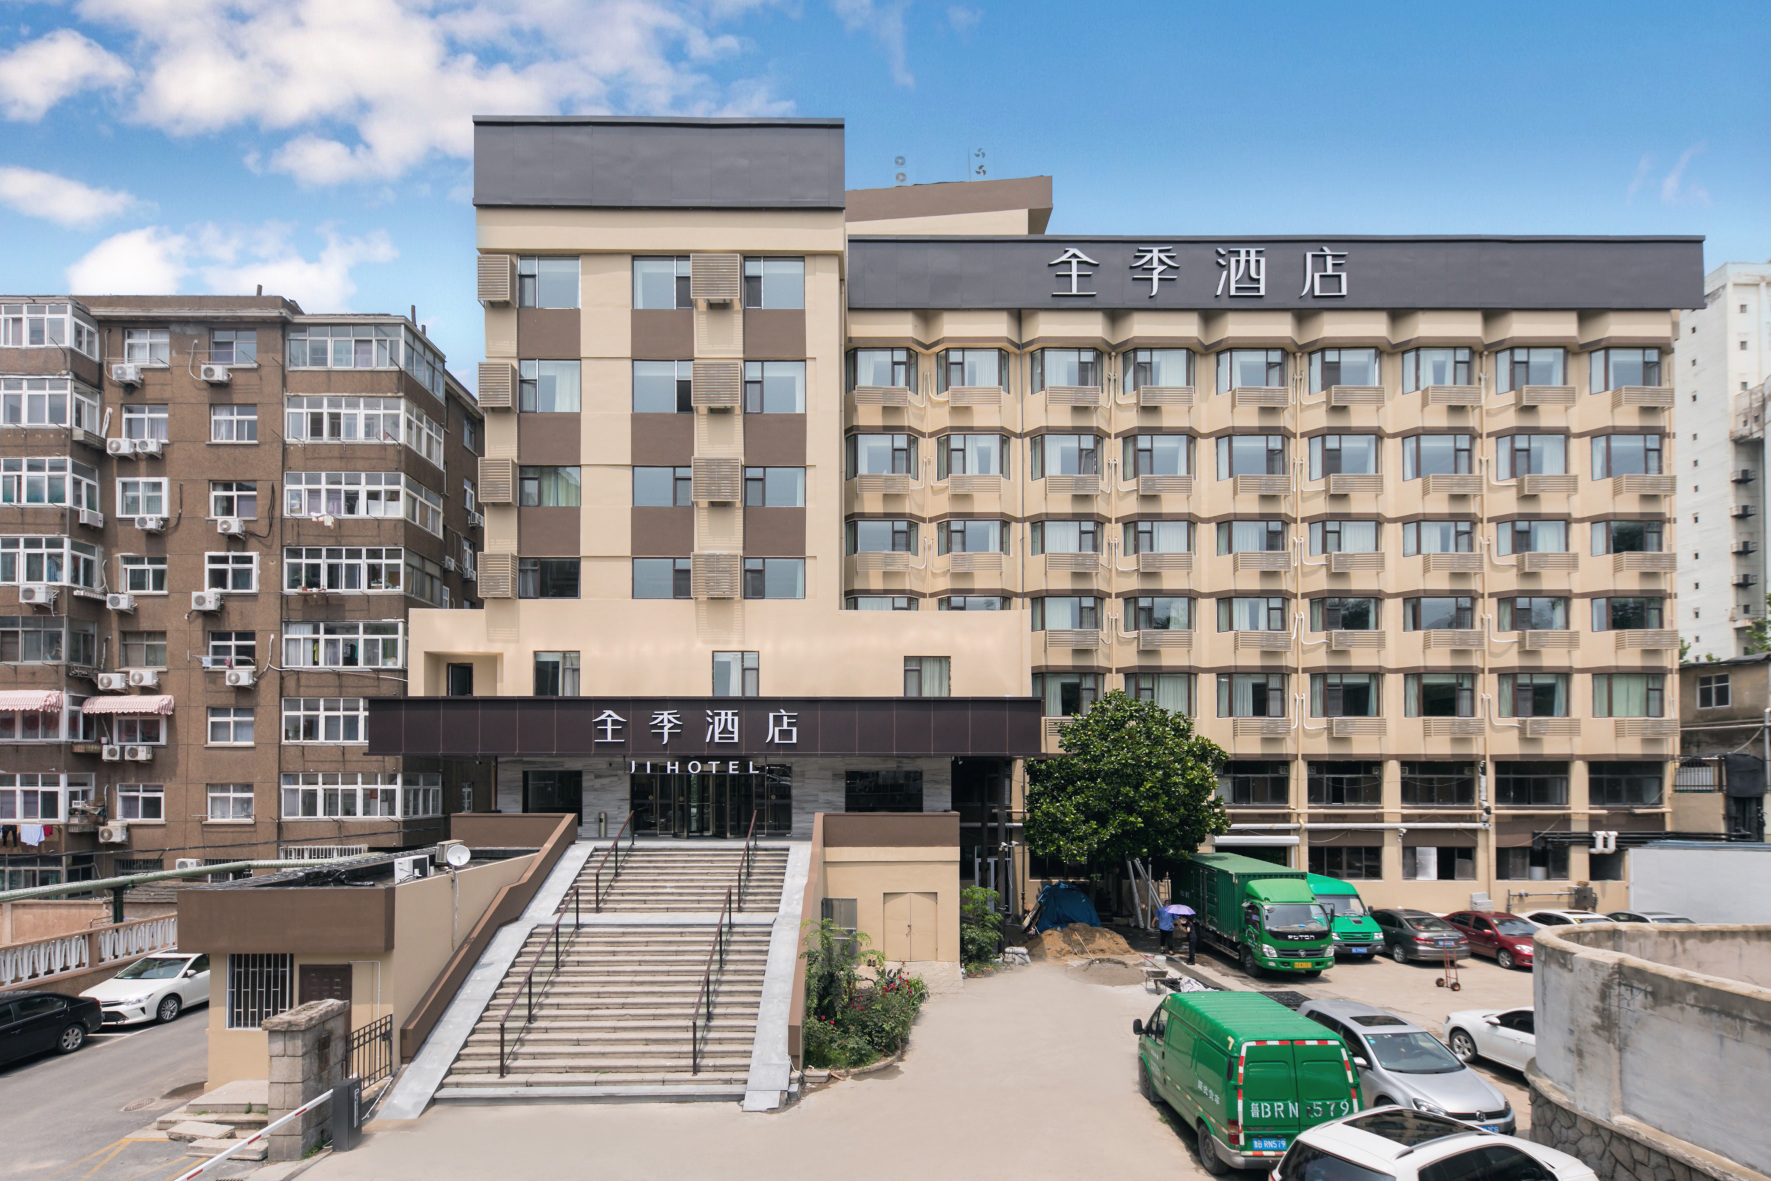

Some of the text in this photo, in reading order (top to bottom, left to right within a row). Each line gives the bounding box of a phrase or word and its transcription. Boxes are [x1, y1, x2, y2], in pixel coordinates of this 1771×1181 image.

[1047, 246, 1349, 299] 全季酒店
[592, 709, 798, 745] 全季酒店
[630, 760, 760, 774] JI HOTEL
